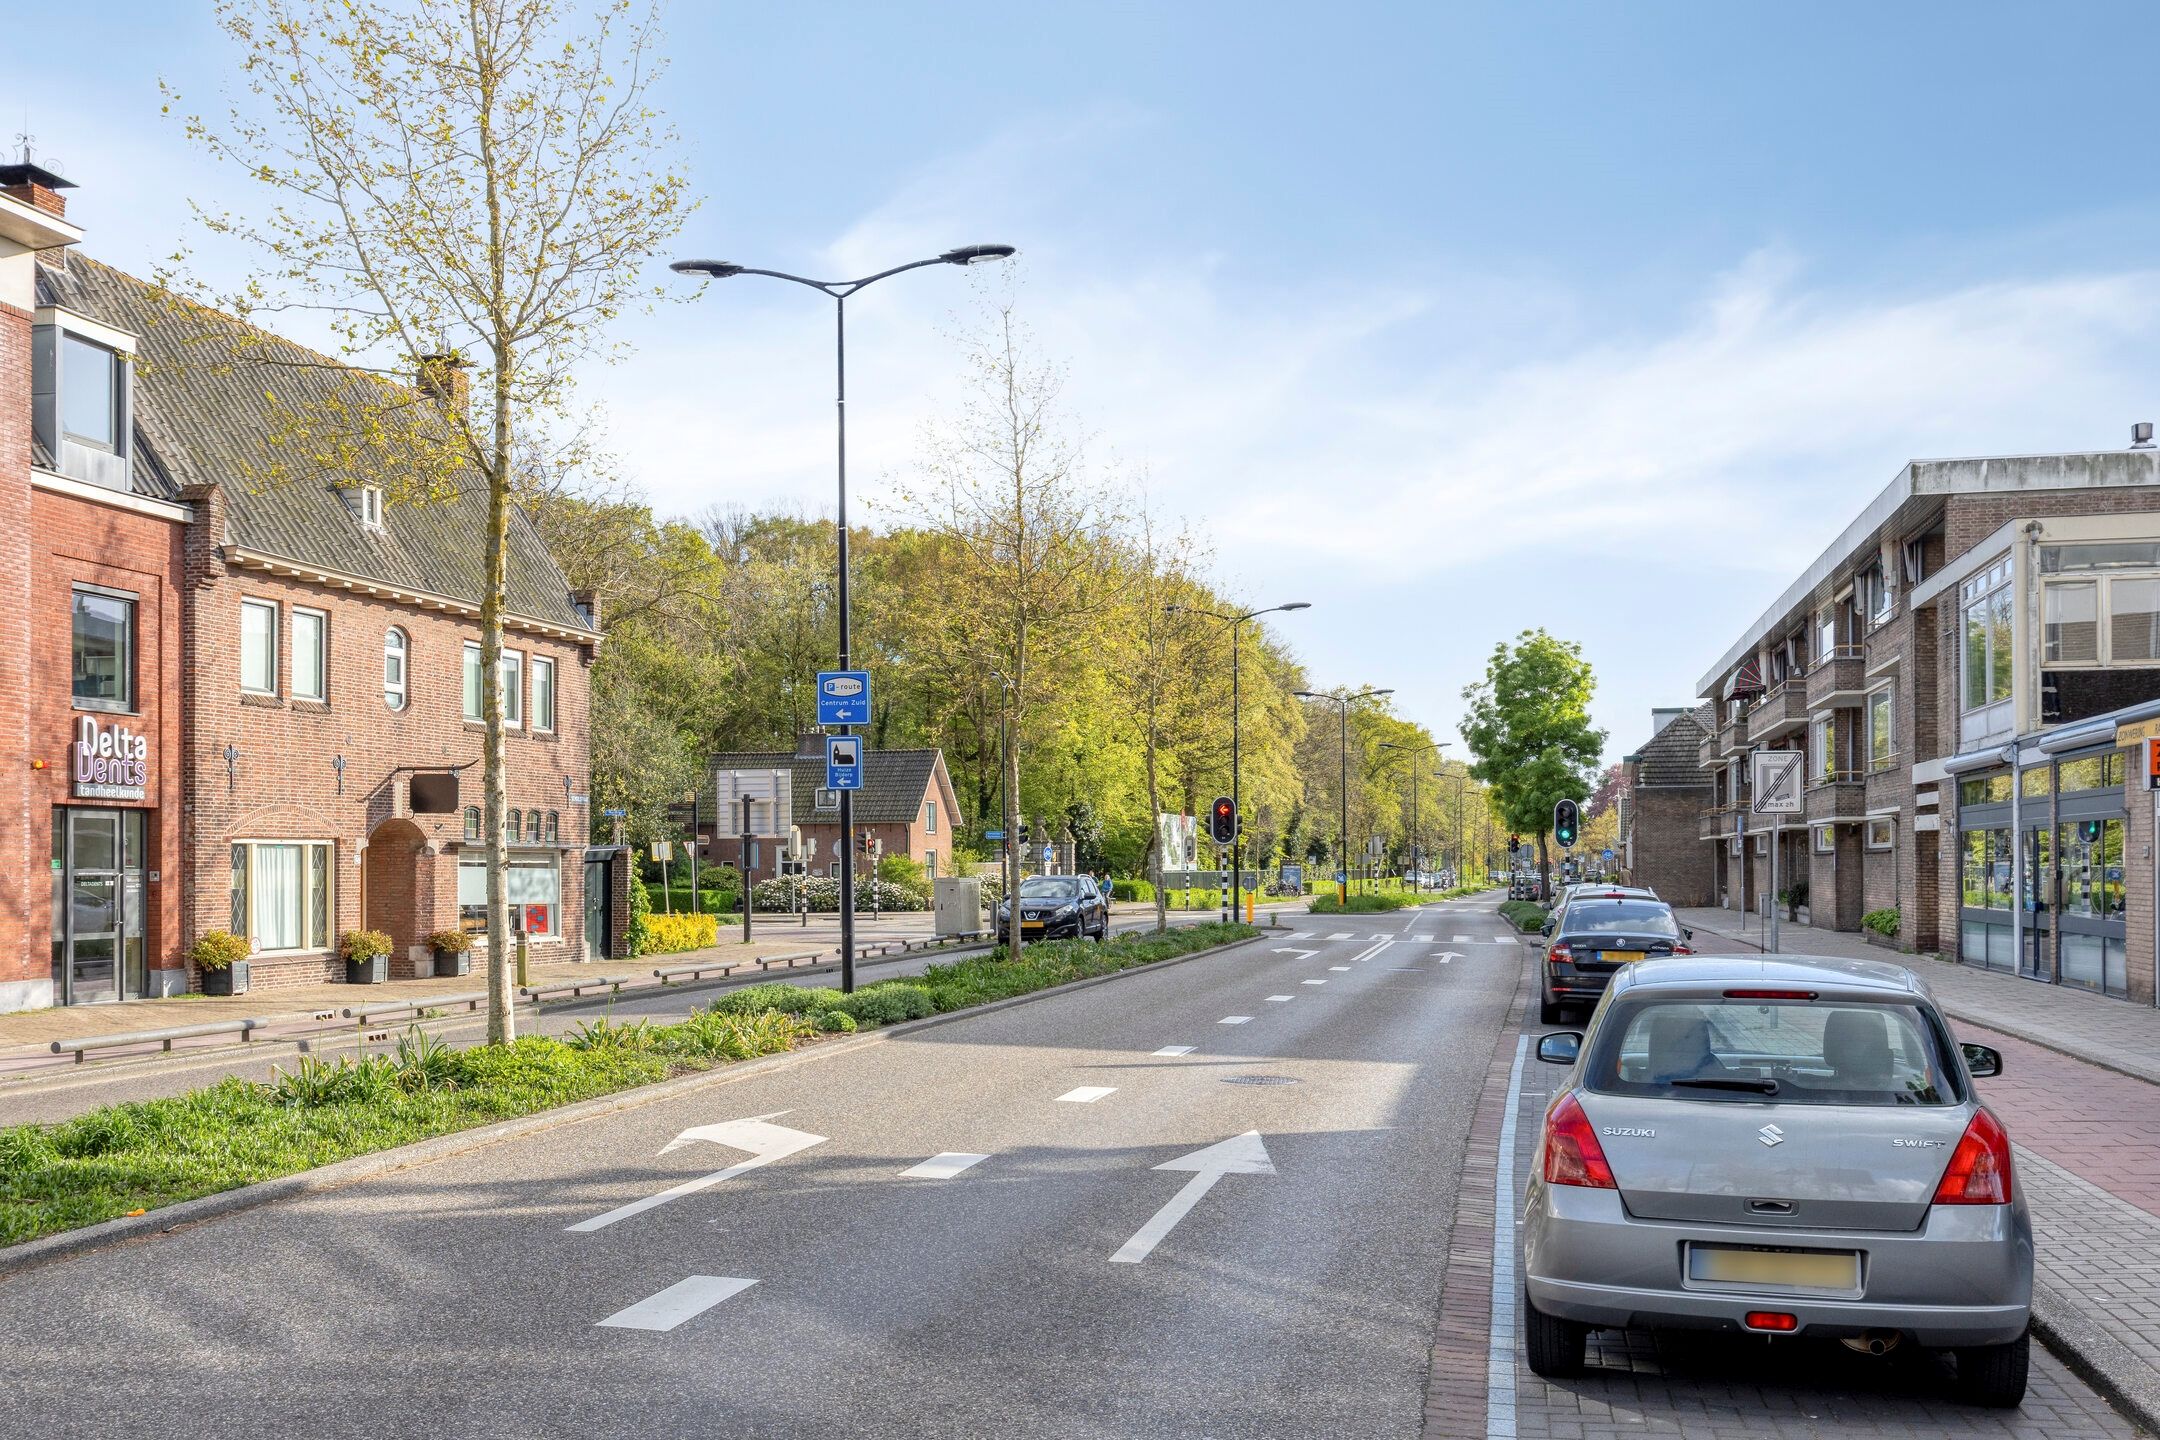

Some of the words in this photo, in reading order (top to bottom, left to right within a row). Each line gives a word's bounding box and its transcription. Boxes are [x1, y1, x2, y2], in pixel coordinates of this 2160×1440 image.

[82, 715, 147, 760] Delta
[77, 741, 147, 786] Dents
[80, 784, 145, 799] tandheelkunde
[1602, 1126, 1656, 1138] SUZUKI
[1892, 1139, 1946, 1149] SWIFT
